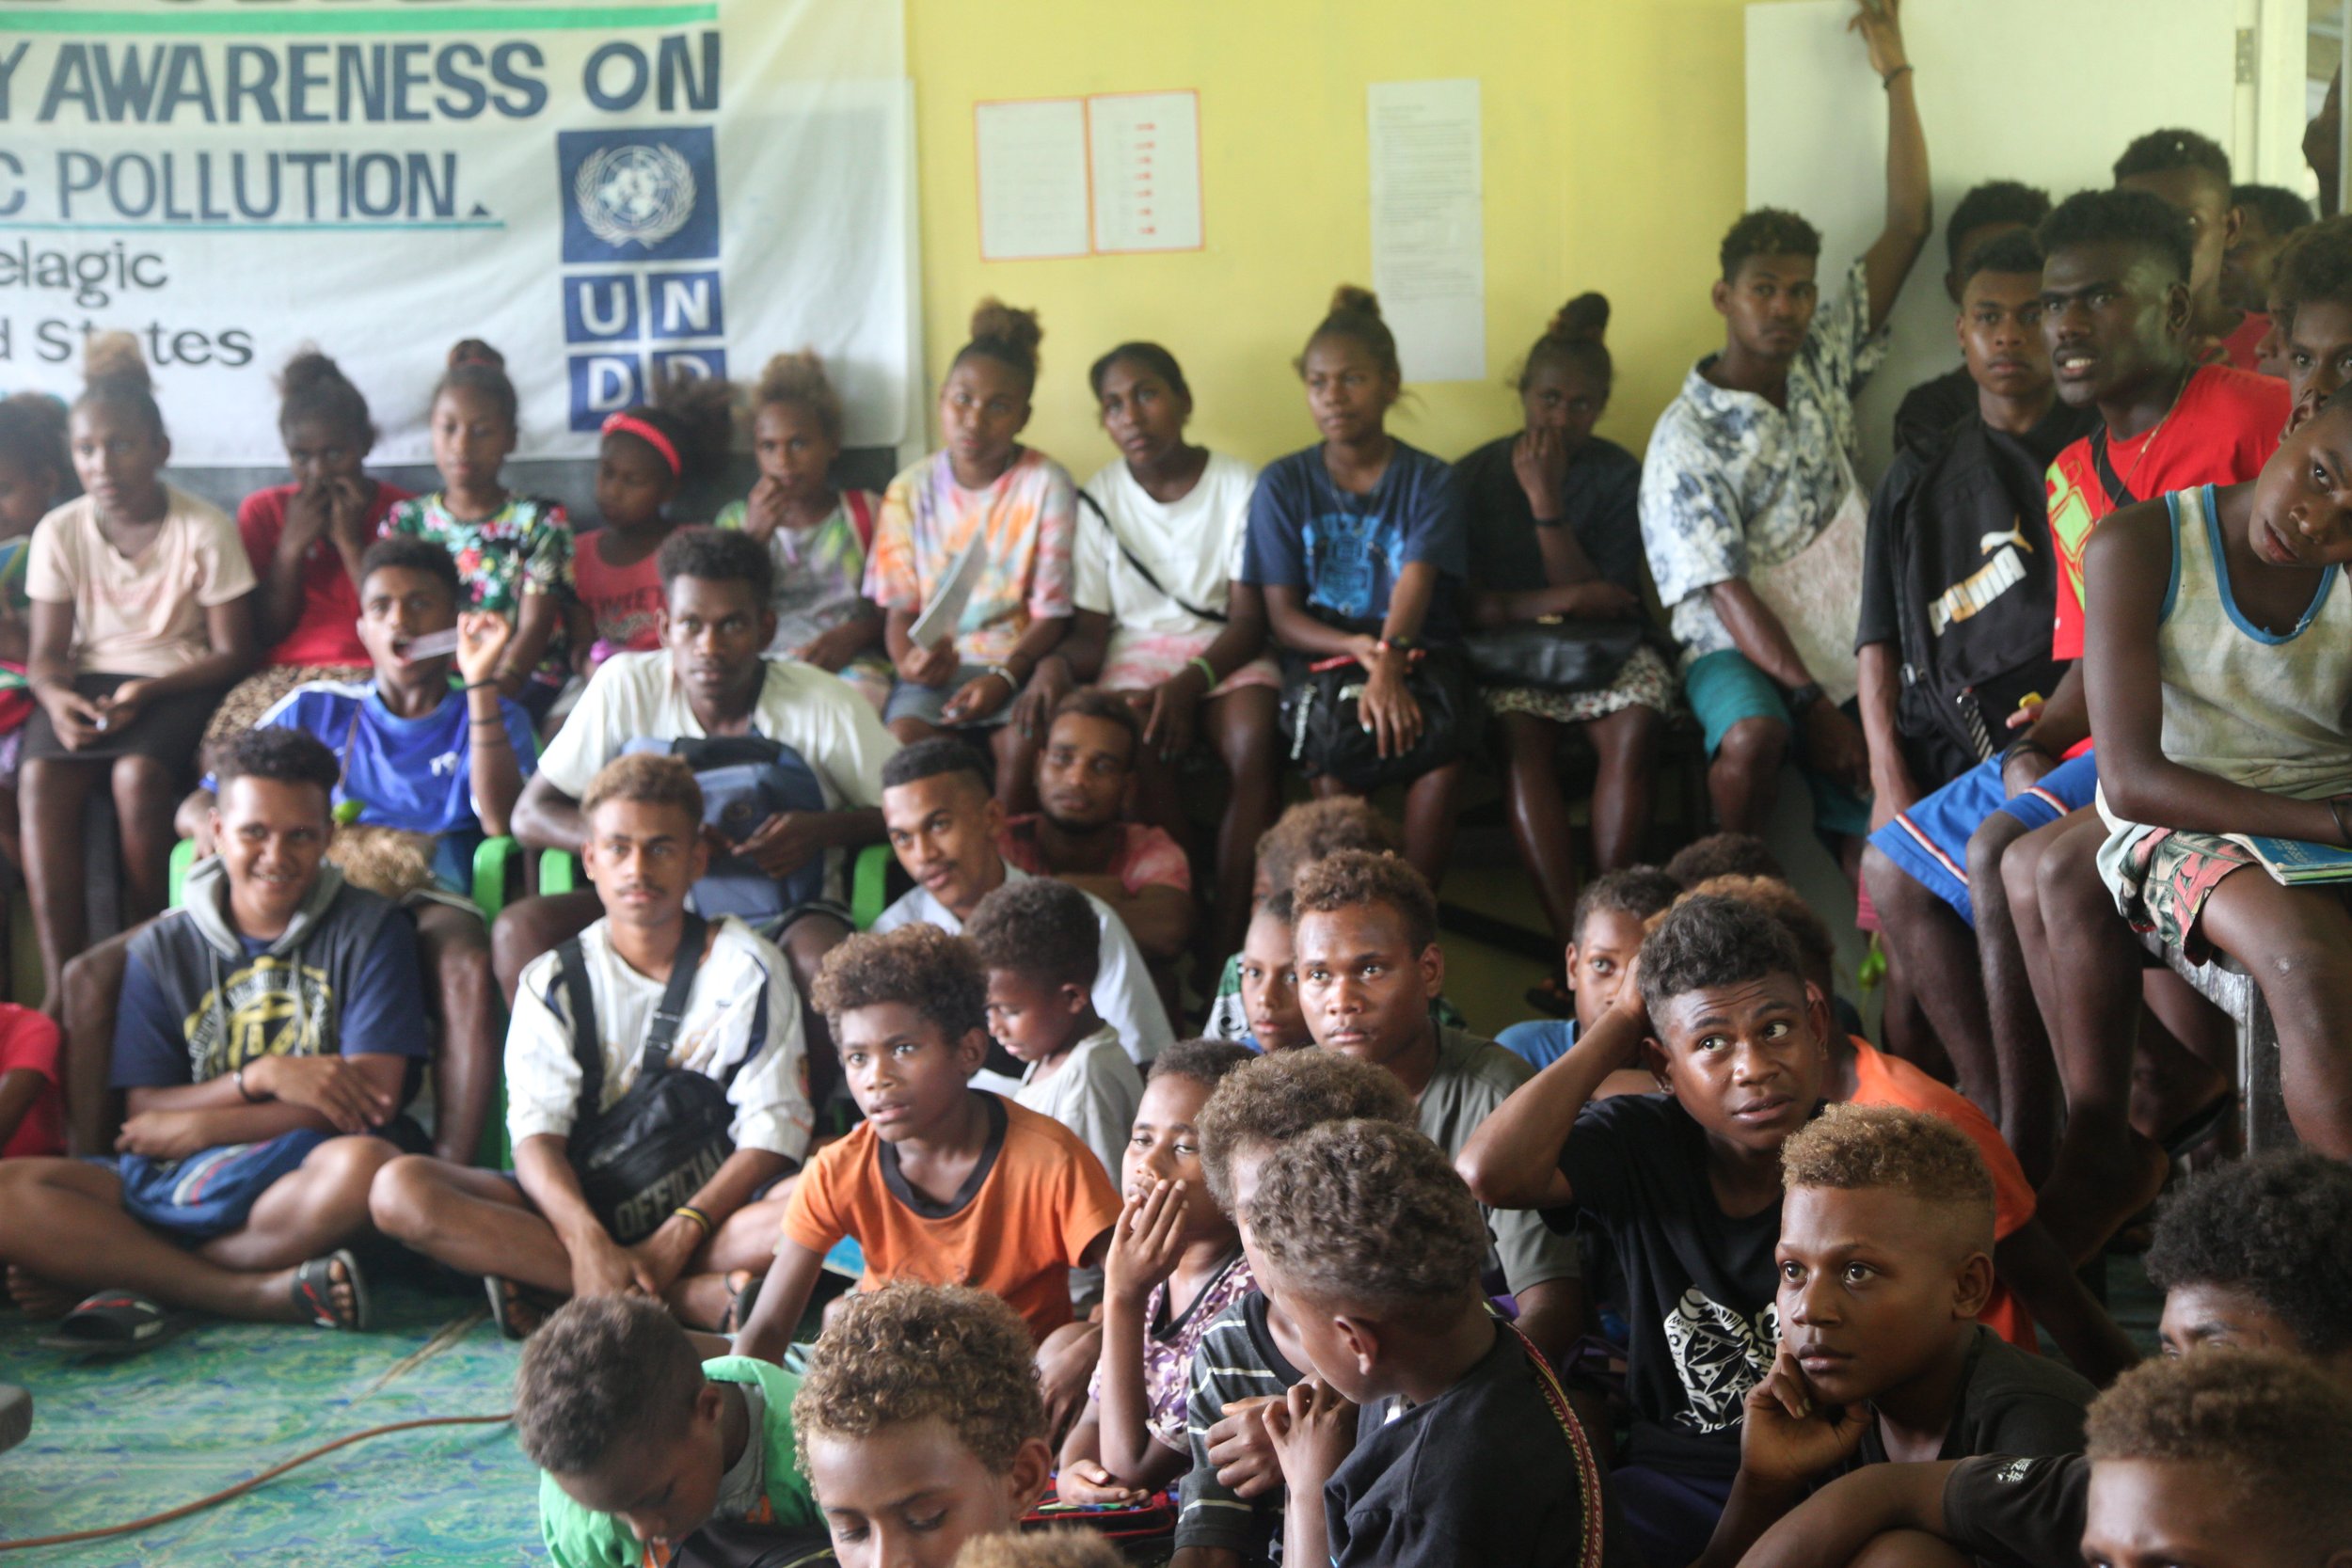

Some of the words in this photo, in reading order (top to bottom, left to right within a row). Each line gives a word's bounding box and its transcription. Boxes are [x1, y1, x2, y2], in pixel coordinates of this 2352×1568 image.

[37, 40, 548, 123] AWARENESS
[583, 31, 721, 112] ON
[56, 150, 490, 220] POLLUTION.
[36, 318, 254, 367] Stes
[1928, 544, 2027, 638] PUMA
